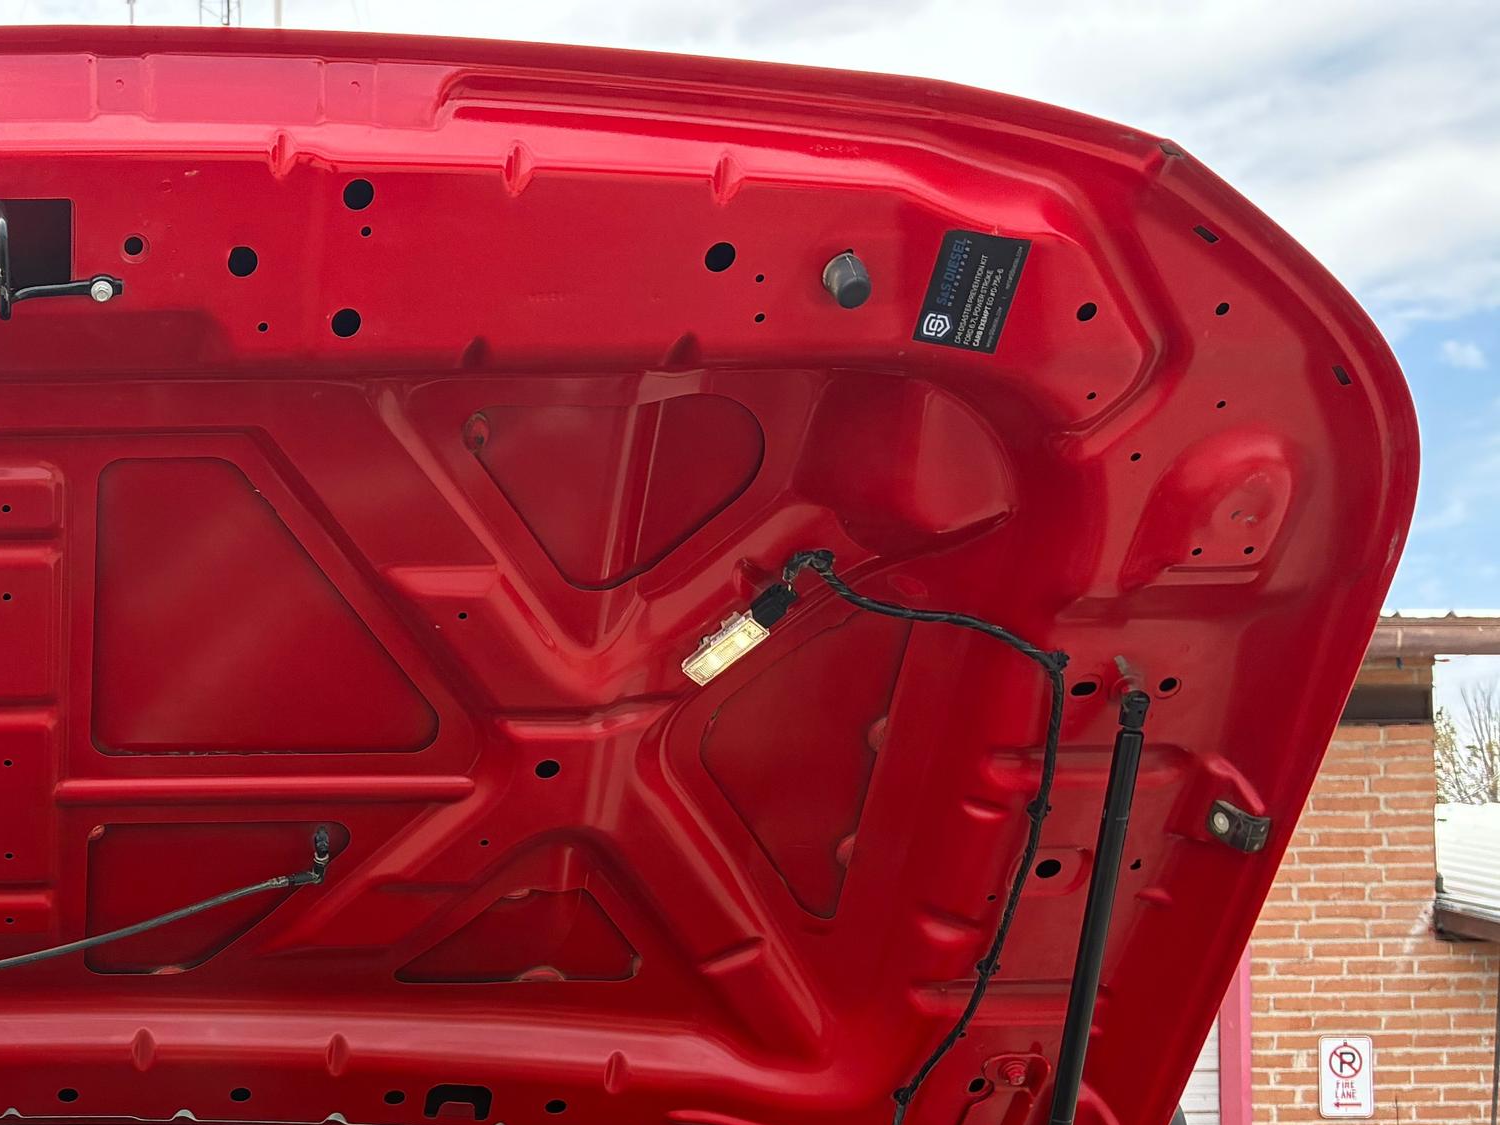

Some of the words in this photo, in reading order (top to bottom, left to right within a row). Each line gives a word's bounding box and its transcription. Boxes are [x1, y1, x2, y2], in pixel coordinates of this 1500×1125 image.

[943, 237, 967, 281] DIESEL
[957, 303, 972, 331] DISASTER
[966, 265, 984, 303] PREVENTION
[963, 328, 973, 345] FORD
[972, 293, 985, 316] POWER
[980, 269, 994, 293] STROKE
[977, 305, 991, 330] EXEMPT
[972, 330, 983, 347] CARB
[1334, 1090, 1356, 1099] LANE
[1336, 1080, 1355, 1089] FIRE
